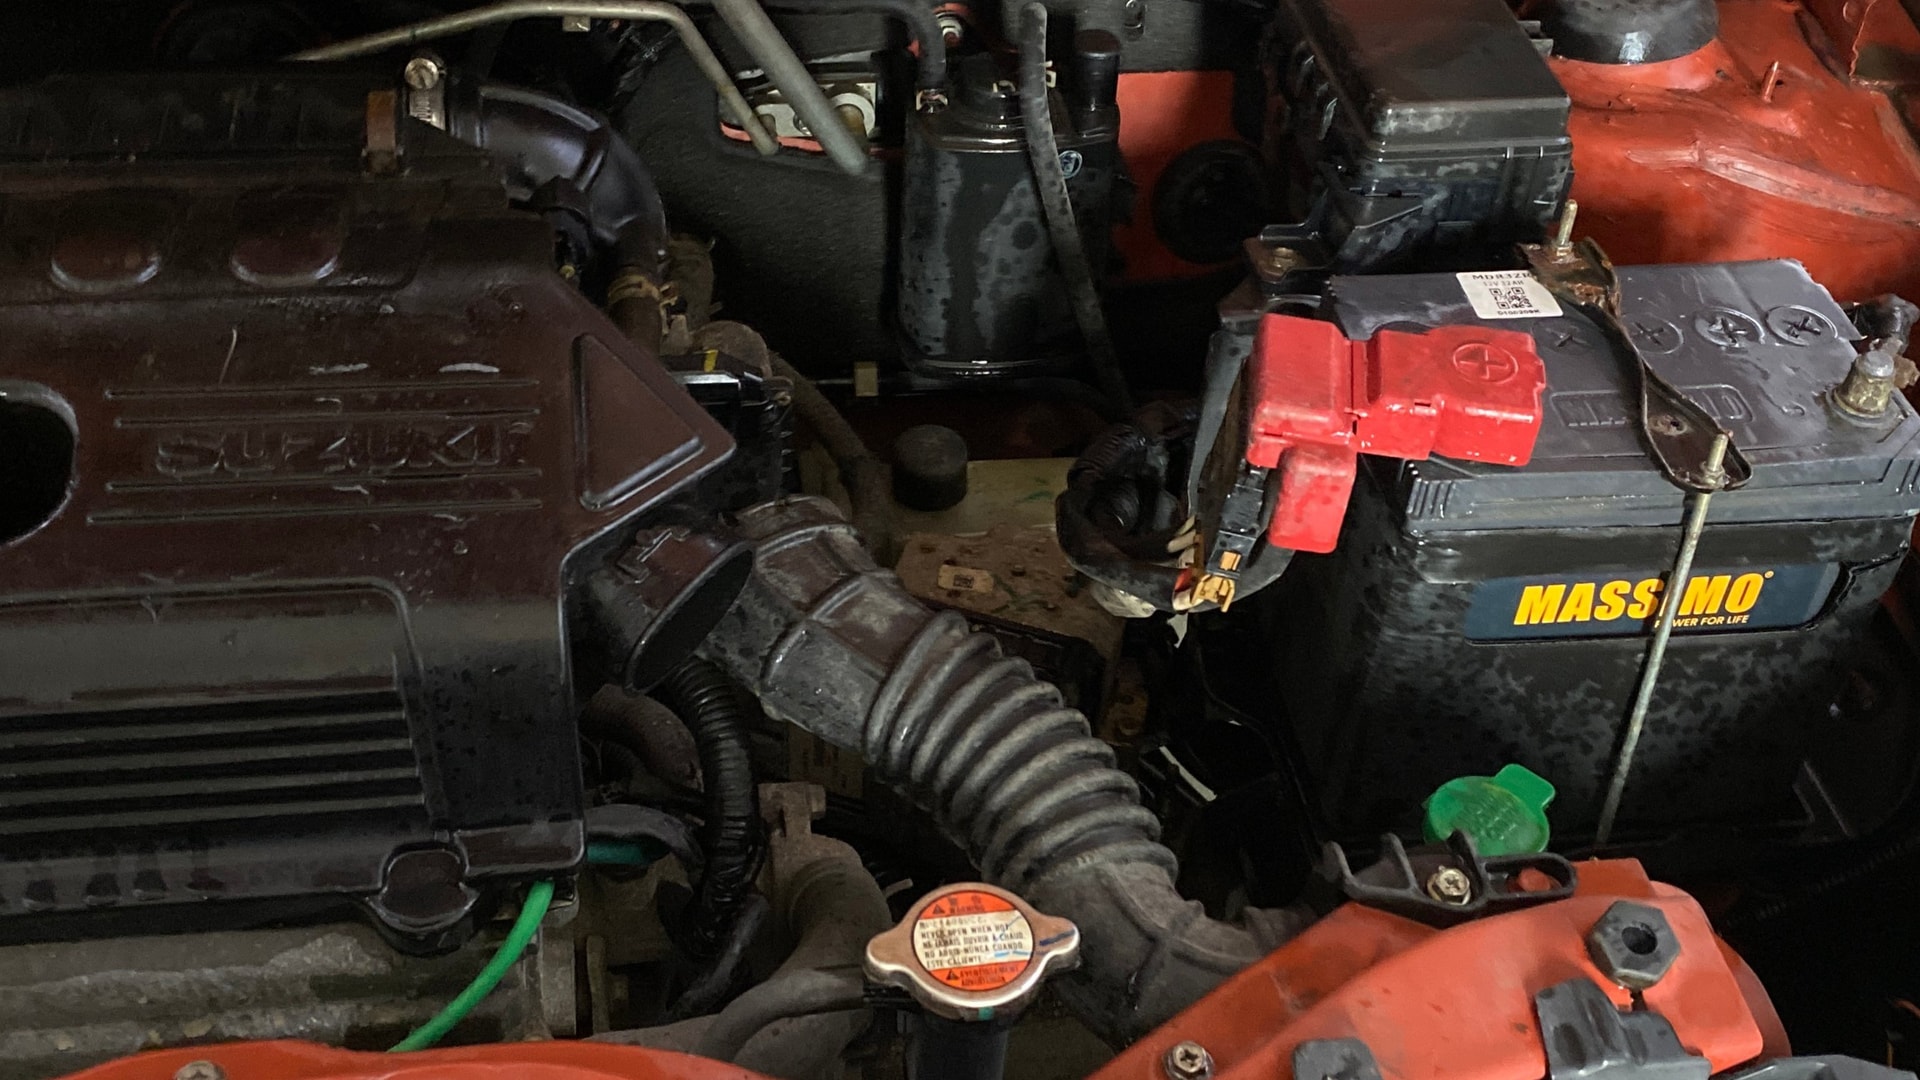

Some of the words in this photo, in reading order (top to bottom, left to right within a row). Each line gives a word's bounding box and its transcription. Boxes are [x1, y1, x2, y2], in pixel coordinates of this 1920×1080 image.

[1514, 572, 1764, 625] MASSMO
[1654, 617, 1698, 628] PWER
[1700, 616, 1725, 626] FOR
[1726, 614, 1750, 624] LIFE
[947, 928, 968, 936] OPEN
[971, 925, 992, 933] WHEN
[924, 950, 935, 958] NO
[963, 944, 989, 954] NUNCA
[992, 941, 1023, 951] CUANDO
